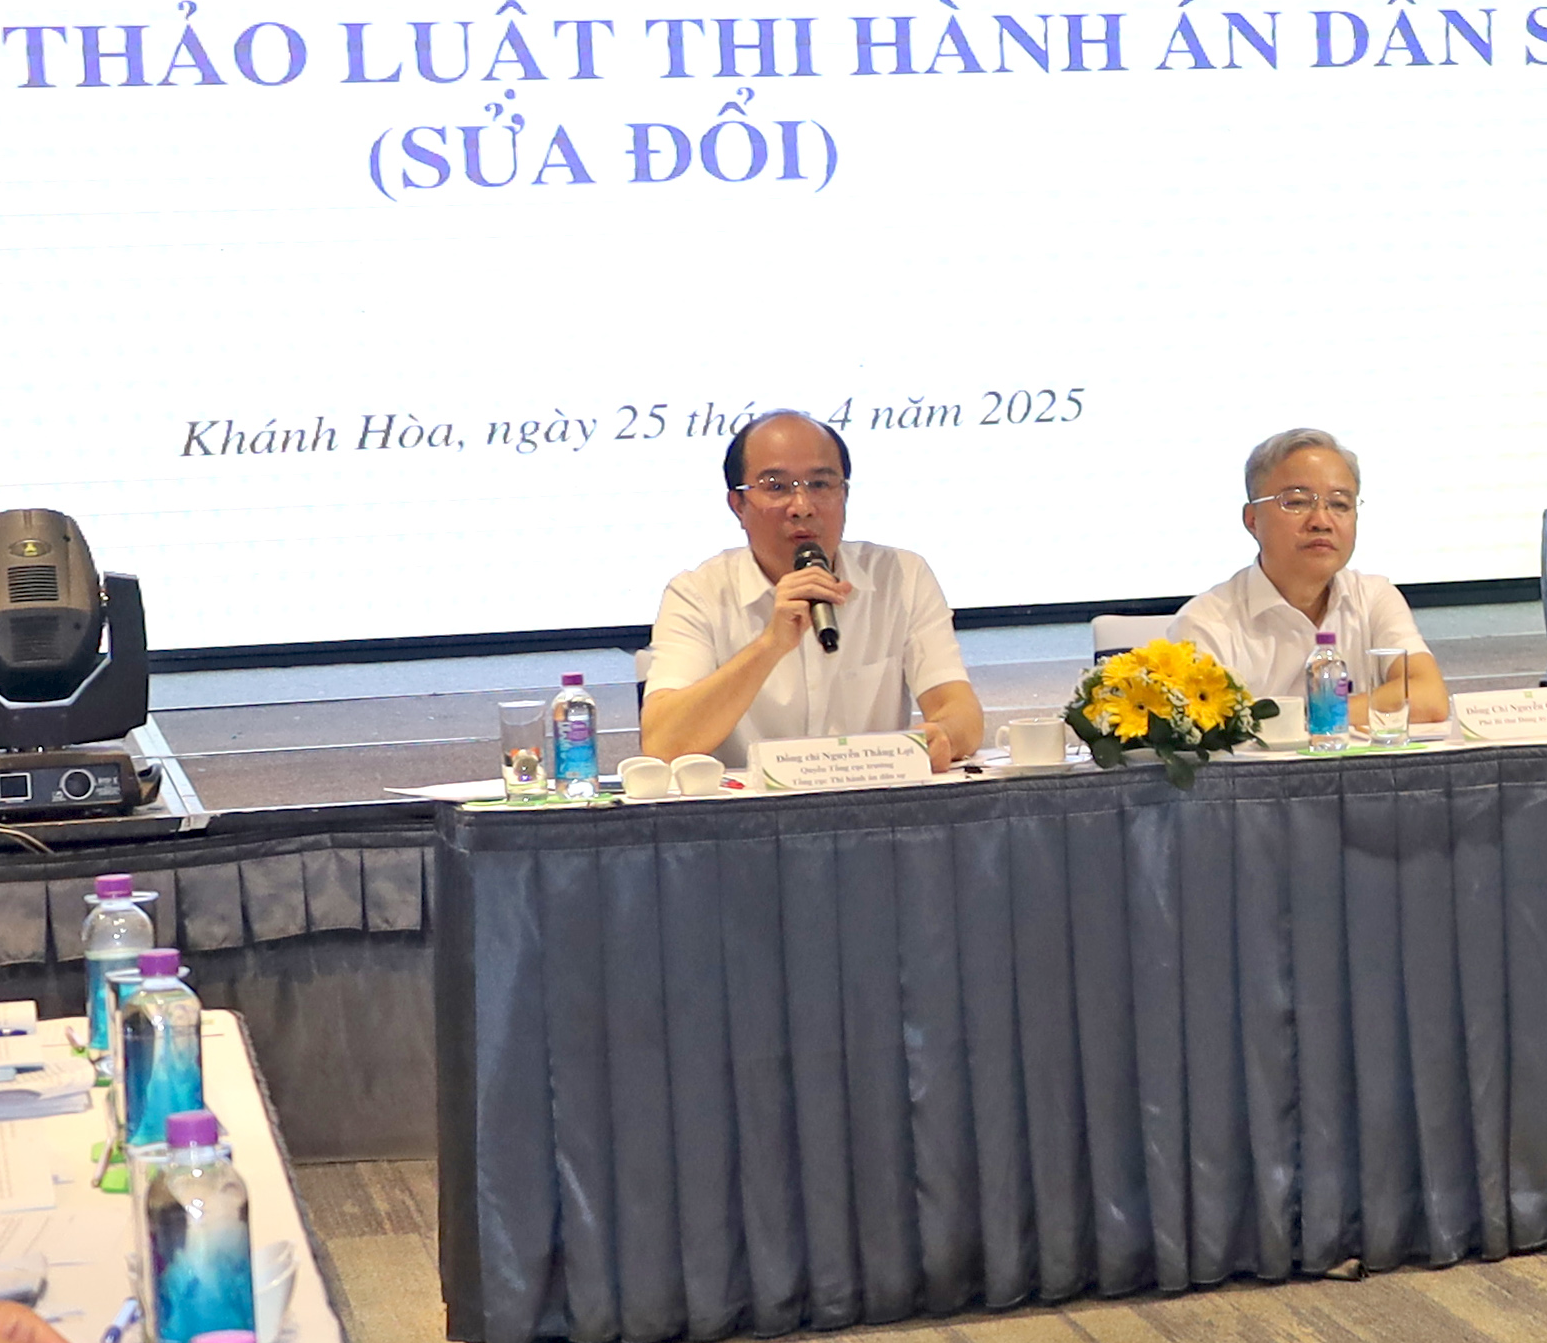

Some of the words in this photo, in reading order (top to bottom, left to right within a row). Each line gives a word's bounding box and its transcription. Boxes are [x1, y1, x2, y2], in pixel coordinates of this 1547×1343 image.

[1, 0, 308, 89] THẢO
[644, 17, 823, 79] THI
[368, 102, 596, 203] (SỬA
[624, 86, 839, 193] ĐỔI)
[180, 415, 339, 457] Khánh
[355, 413, 465, 452] Hòa,
[486, 407, 598, 456] ngày
[614, 403, 668, 441] 25
[686, 401, 810, 438] thá
[827, 397, 854, 432] 4
[870, 395, 962, 431] năm
[979, 387, 1086, 426] 2025
